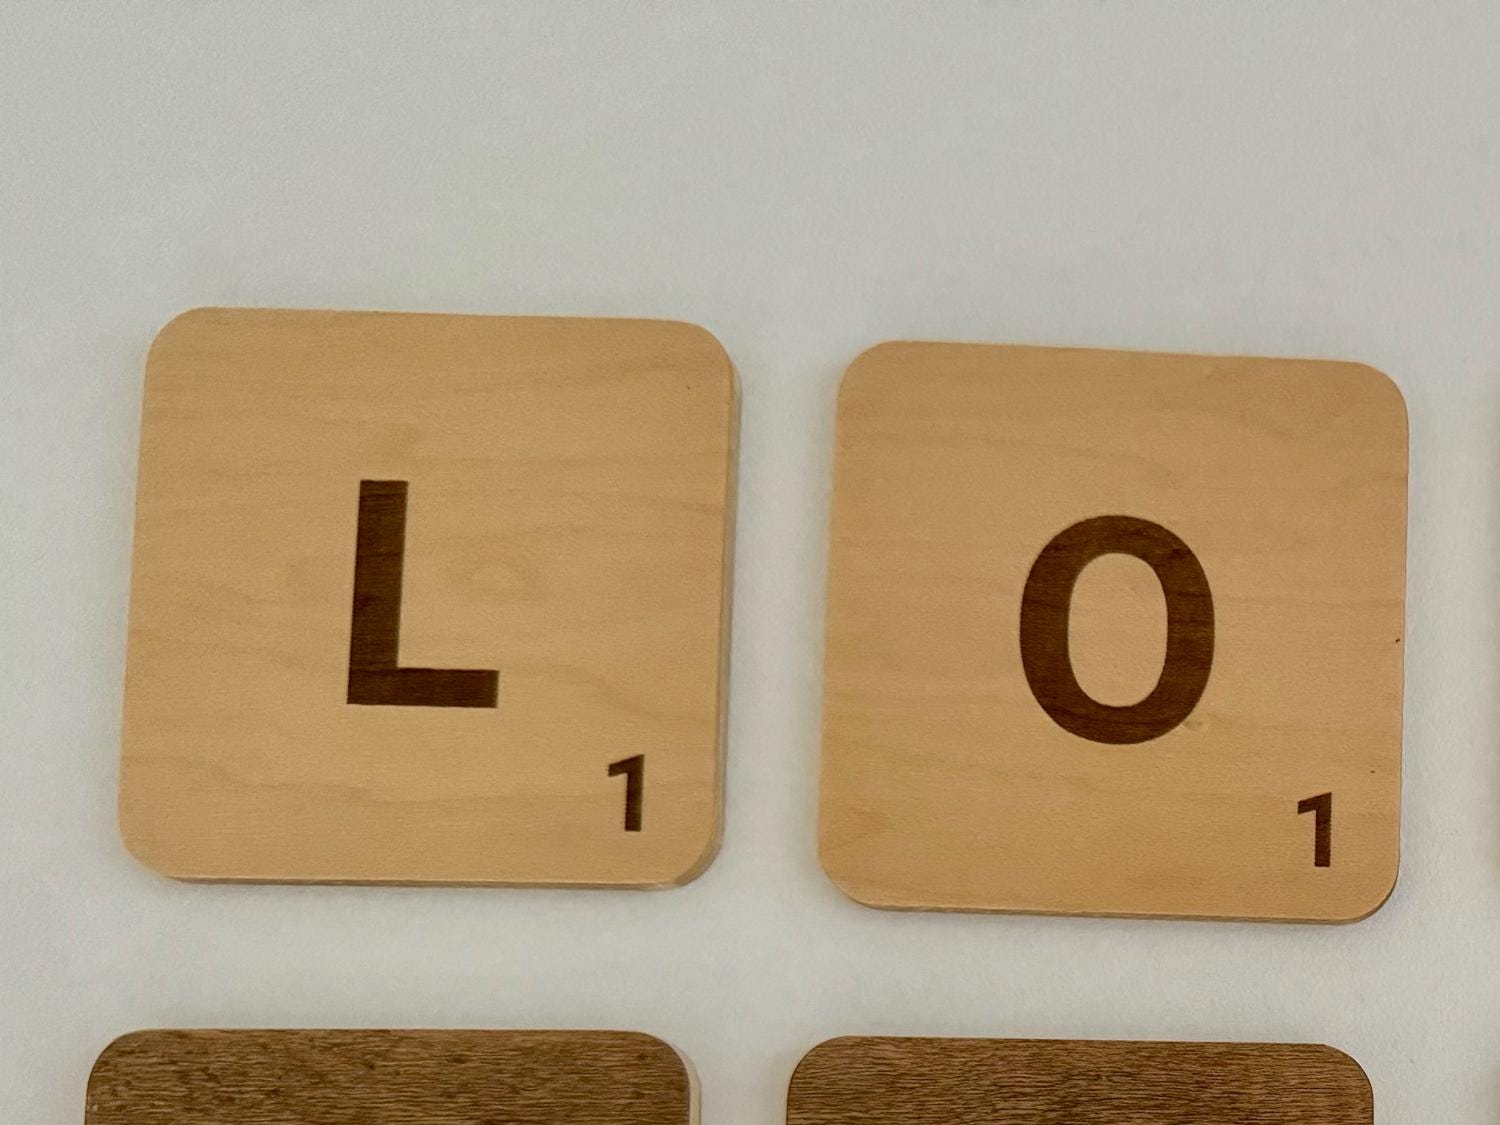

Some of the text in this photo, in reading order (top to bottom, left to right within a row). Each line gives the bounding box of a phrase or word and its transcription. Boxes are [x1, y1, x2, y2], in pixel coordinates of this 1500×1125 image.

[347, 480, 499, 708] L
[1019, 515, 1214, 745] O
[607, 754, 644, 831] 1
[1297, 792, 1332, 867] 1
